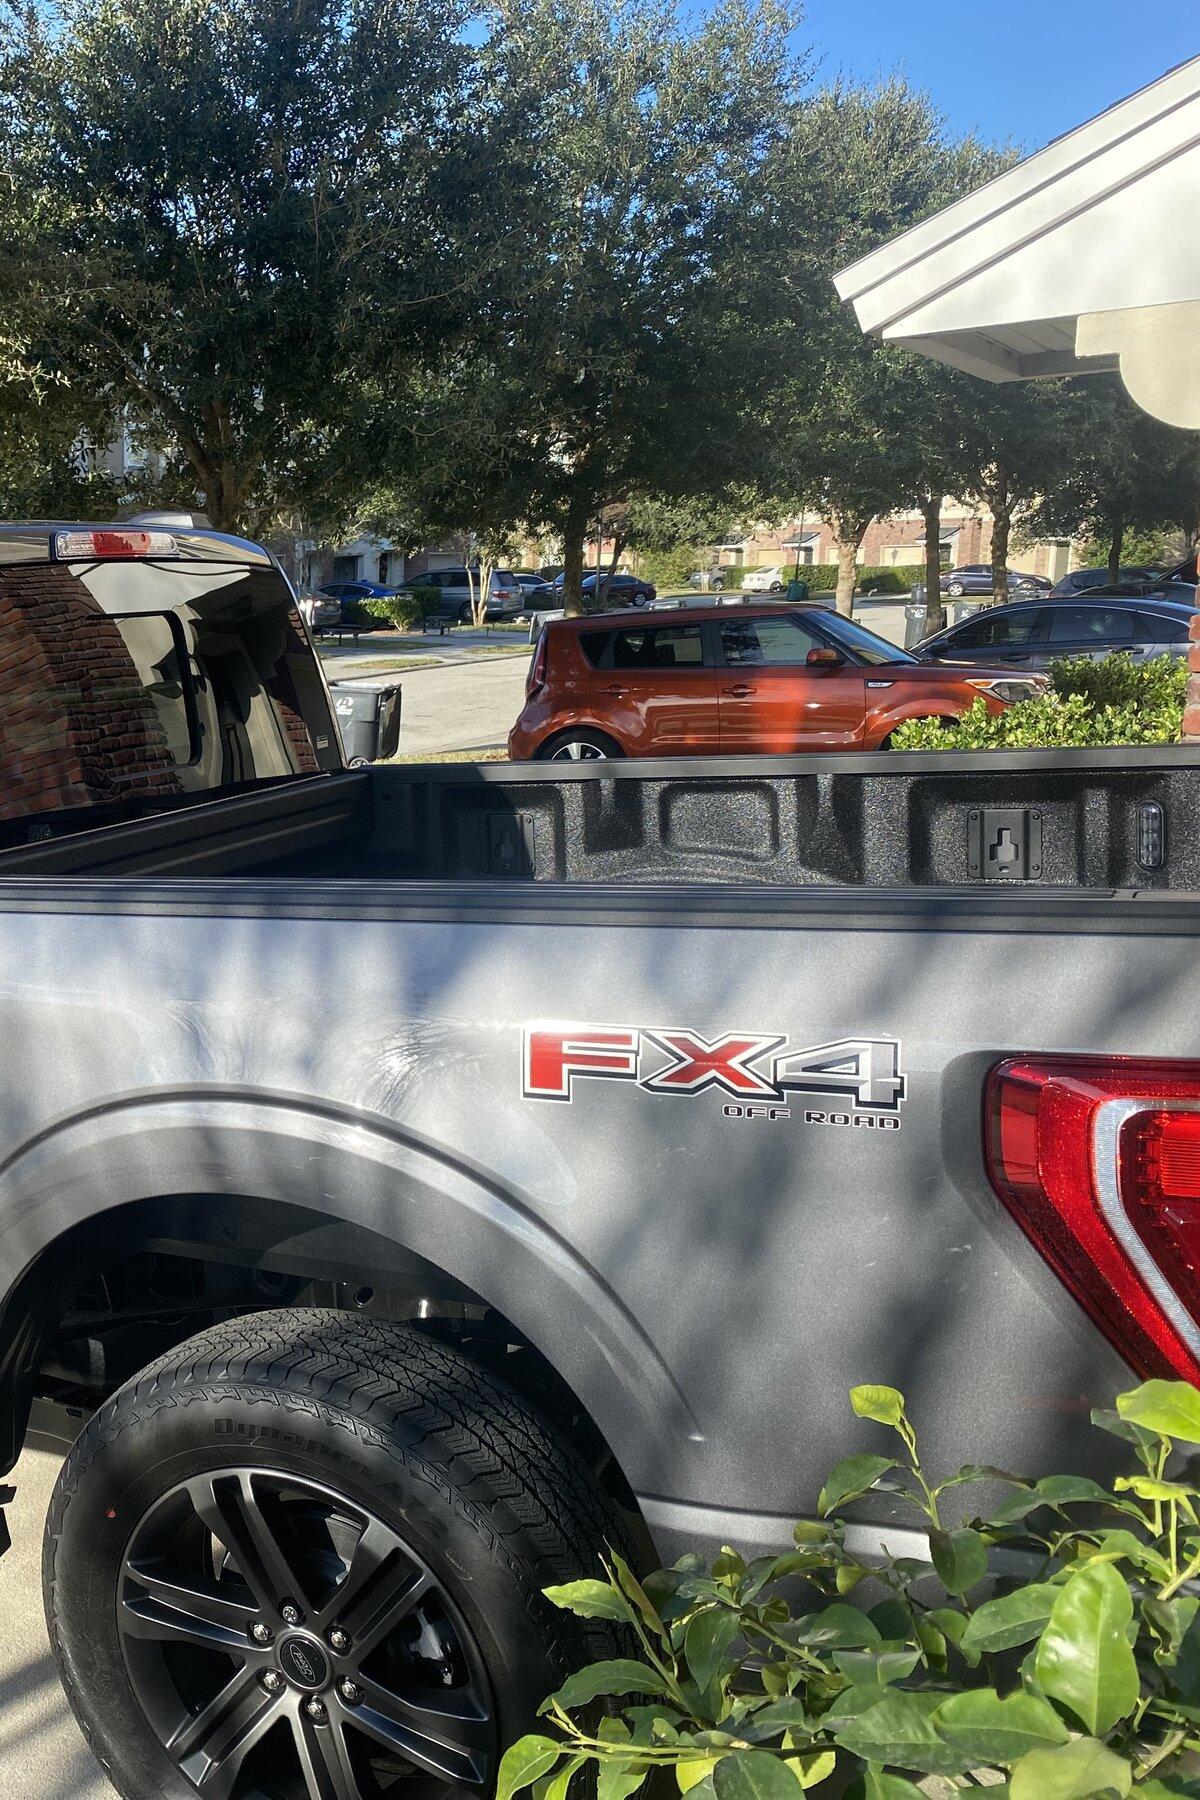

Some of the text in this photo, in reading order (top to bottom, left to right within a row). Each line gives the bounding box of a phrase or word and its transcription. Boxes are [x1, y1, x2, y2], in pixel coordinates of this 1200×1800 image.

[520, 1019, 907, 1111] FX4
[723, 1104, 901, 1131] OFF ROAD
